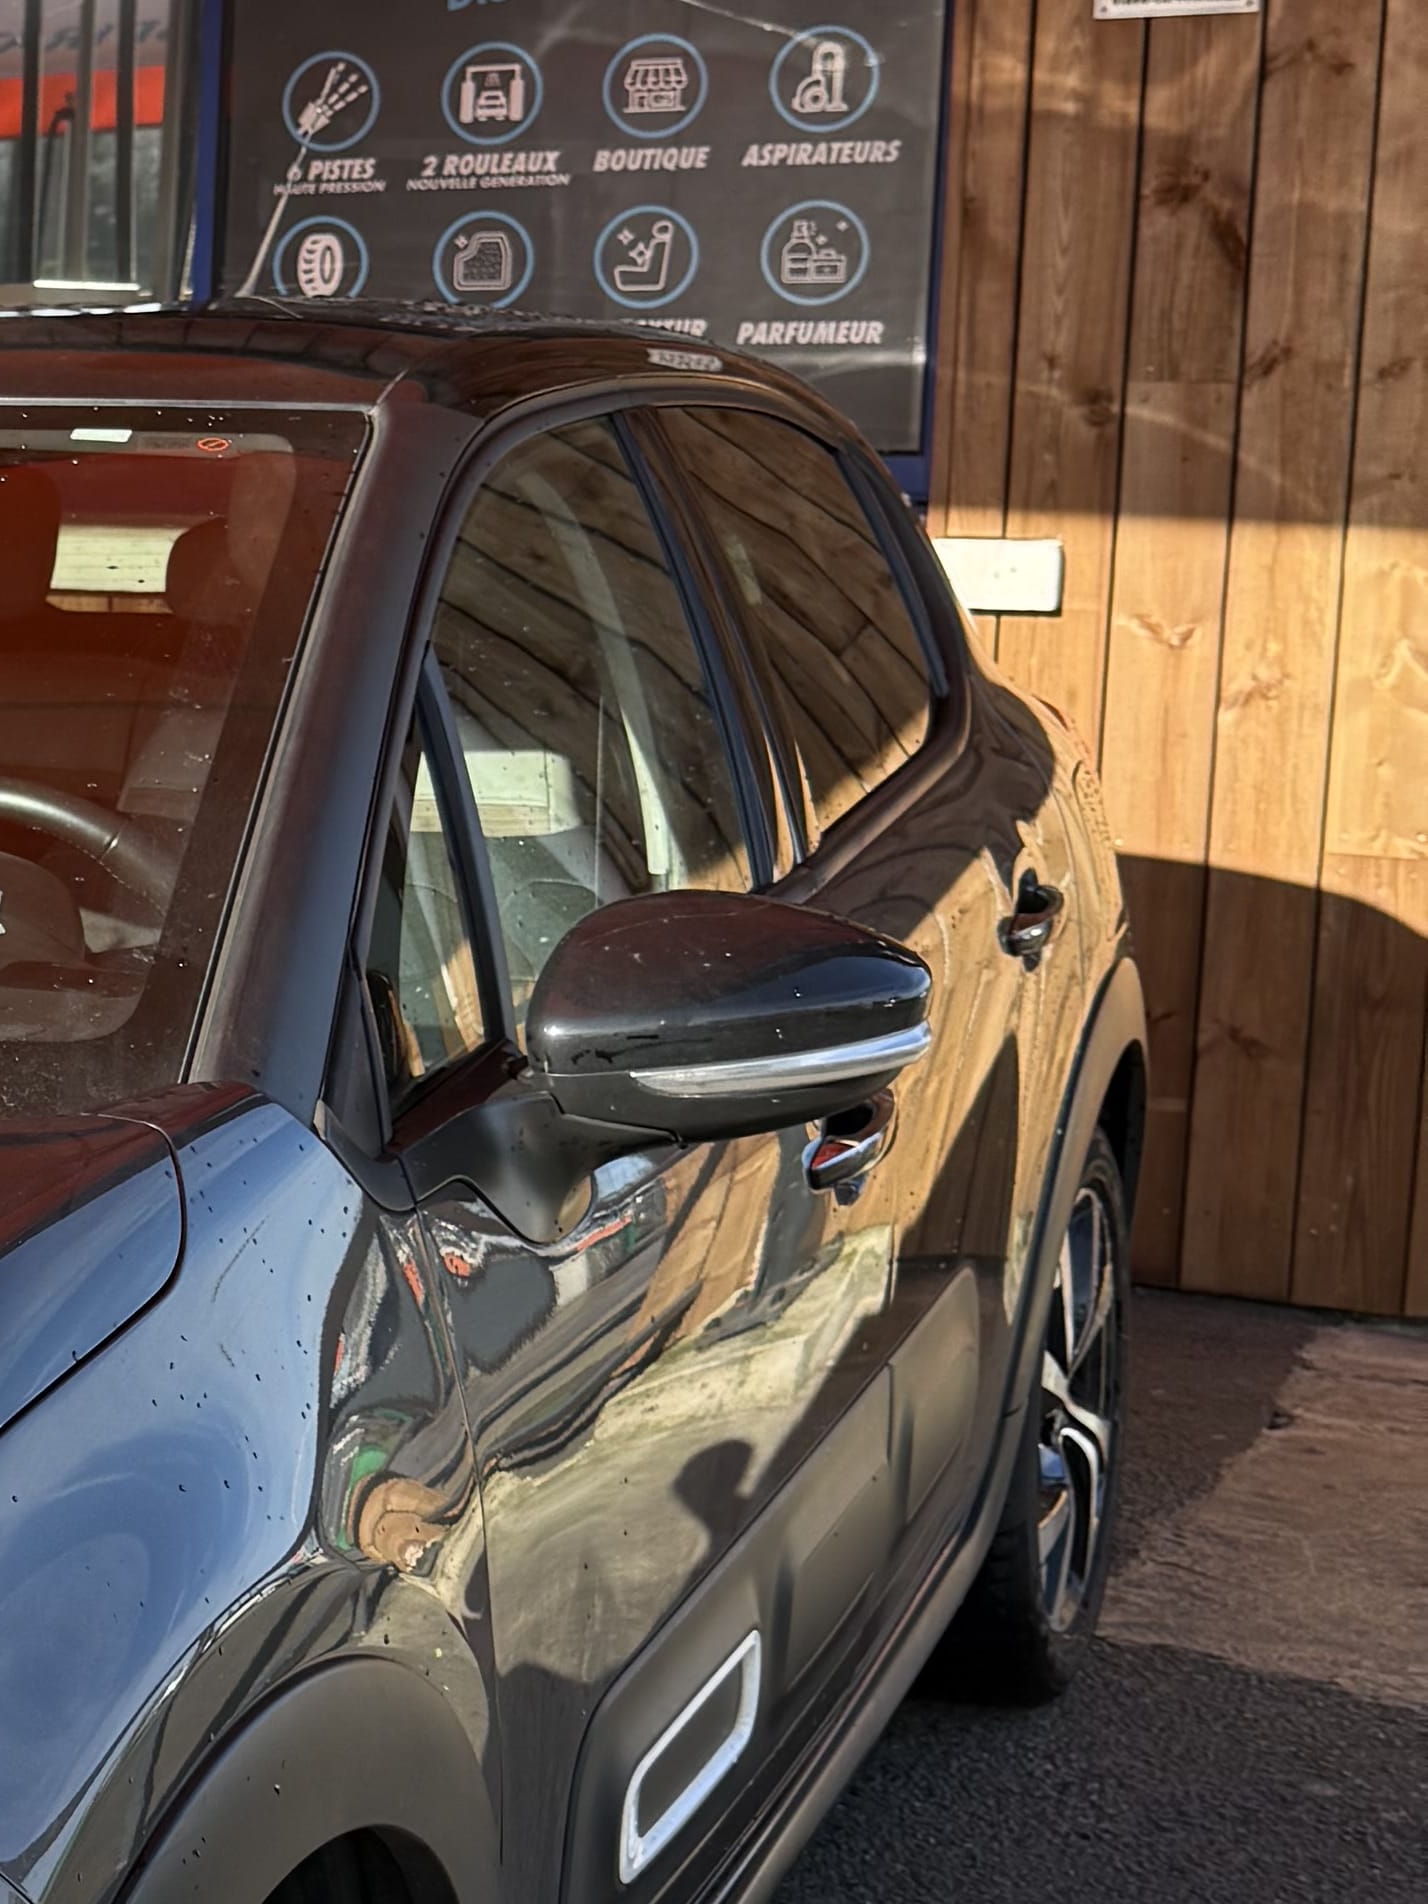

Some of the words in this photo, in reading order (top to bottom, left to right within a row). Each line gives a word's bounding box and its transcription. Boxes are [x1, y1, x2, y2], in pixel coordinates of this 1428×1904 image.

[421, 155, 438, 177] 2
[443, 150, 561, 176] ROULEAUX
[593, 145, 710, 172] BOUTIQUE
[741, 140, 902, 167] ASPIRATEURS
[307, 158, 376, 181] PISTES
[736, 319, 885, 345] PARFUMEUR
